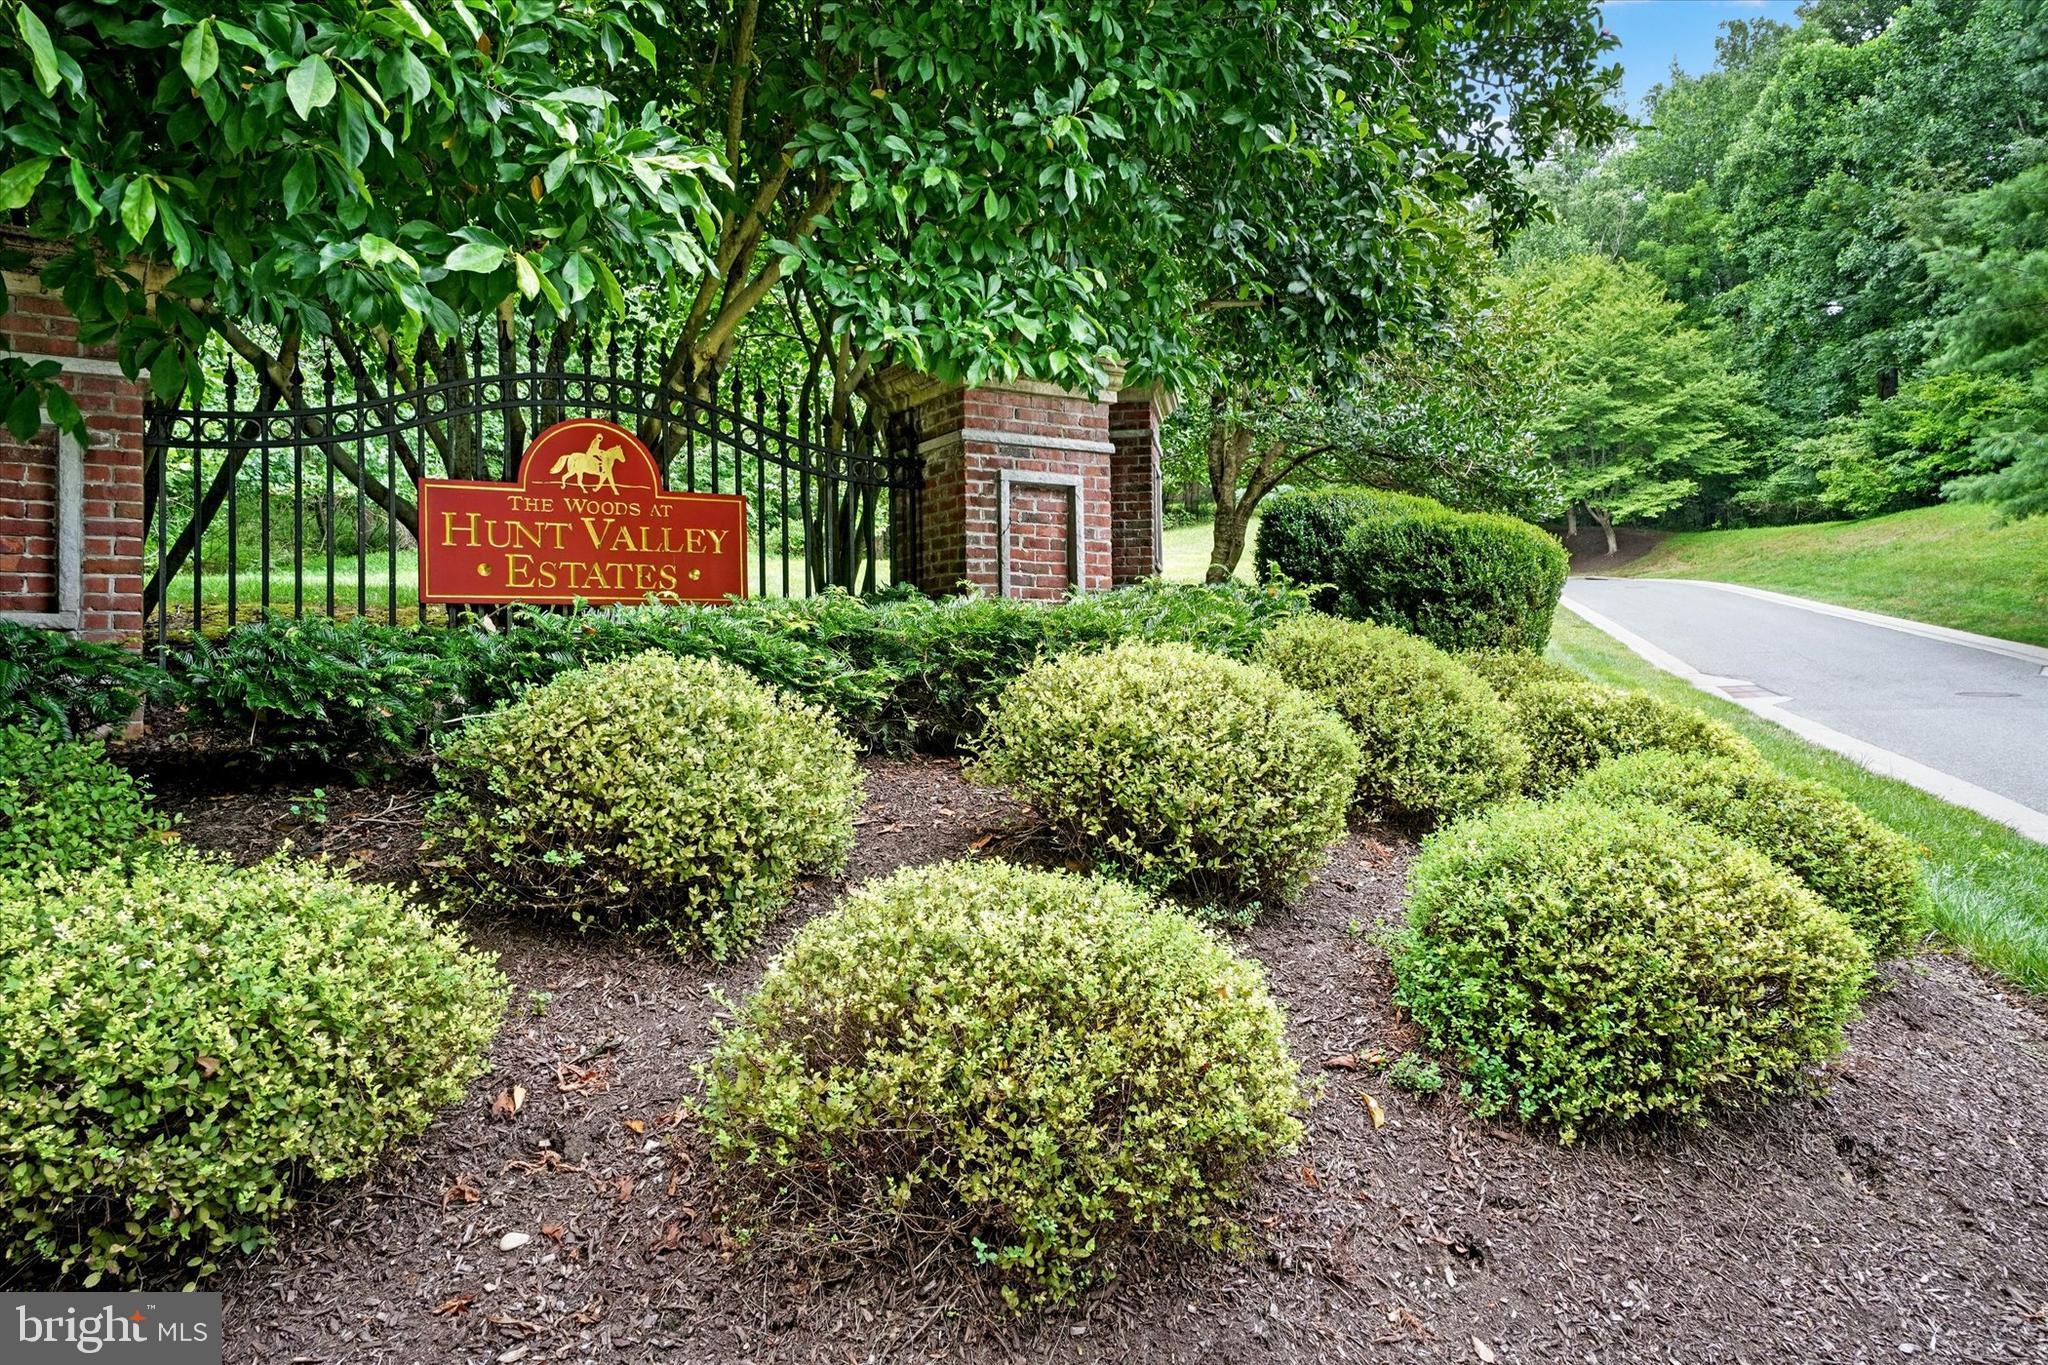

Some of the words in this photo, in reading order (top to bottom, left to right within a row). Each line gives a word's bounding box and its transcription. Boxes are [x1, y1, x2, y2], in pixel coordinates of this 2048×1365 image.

[507, 495, 554, 513] THE
[564, 497, 641, 517] WOODS
[650, 503, 673, 518] AT
[441, 512, 573, 549] HUNT
[580, 517, 729, 554] VALLEY
[504, 553, 678, 591] ESTATES
